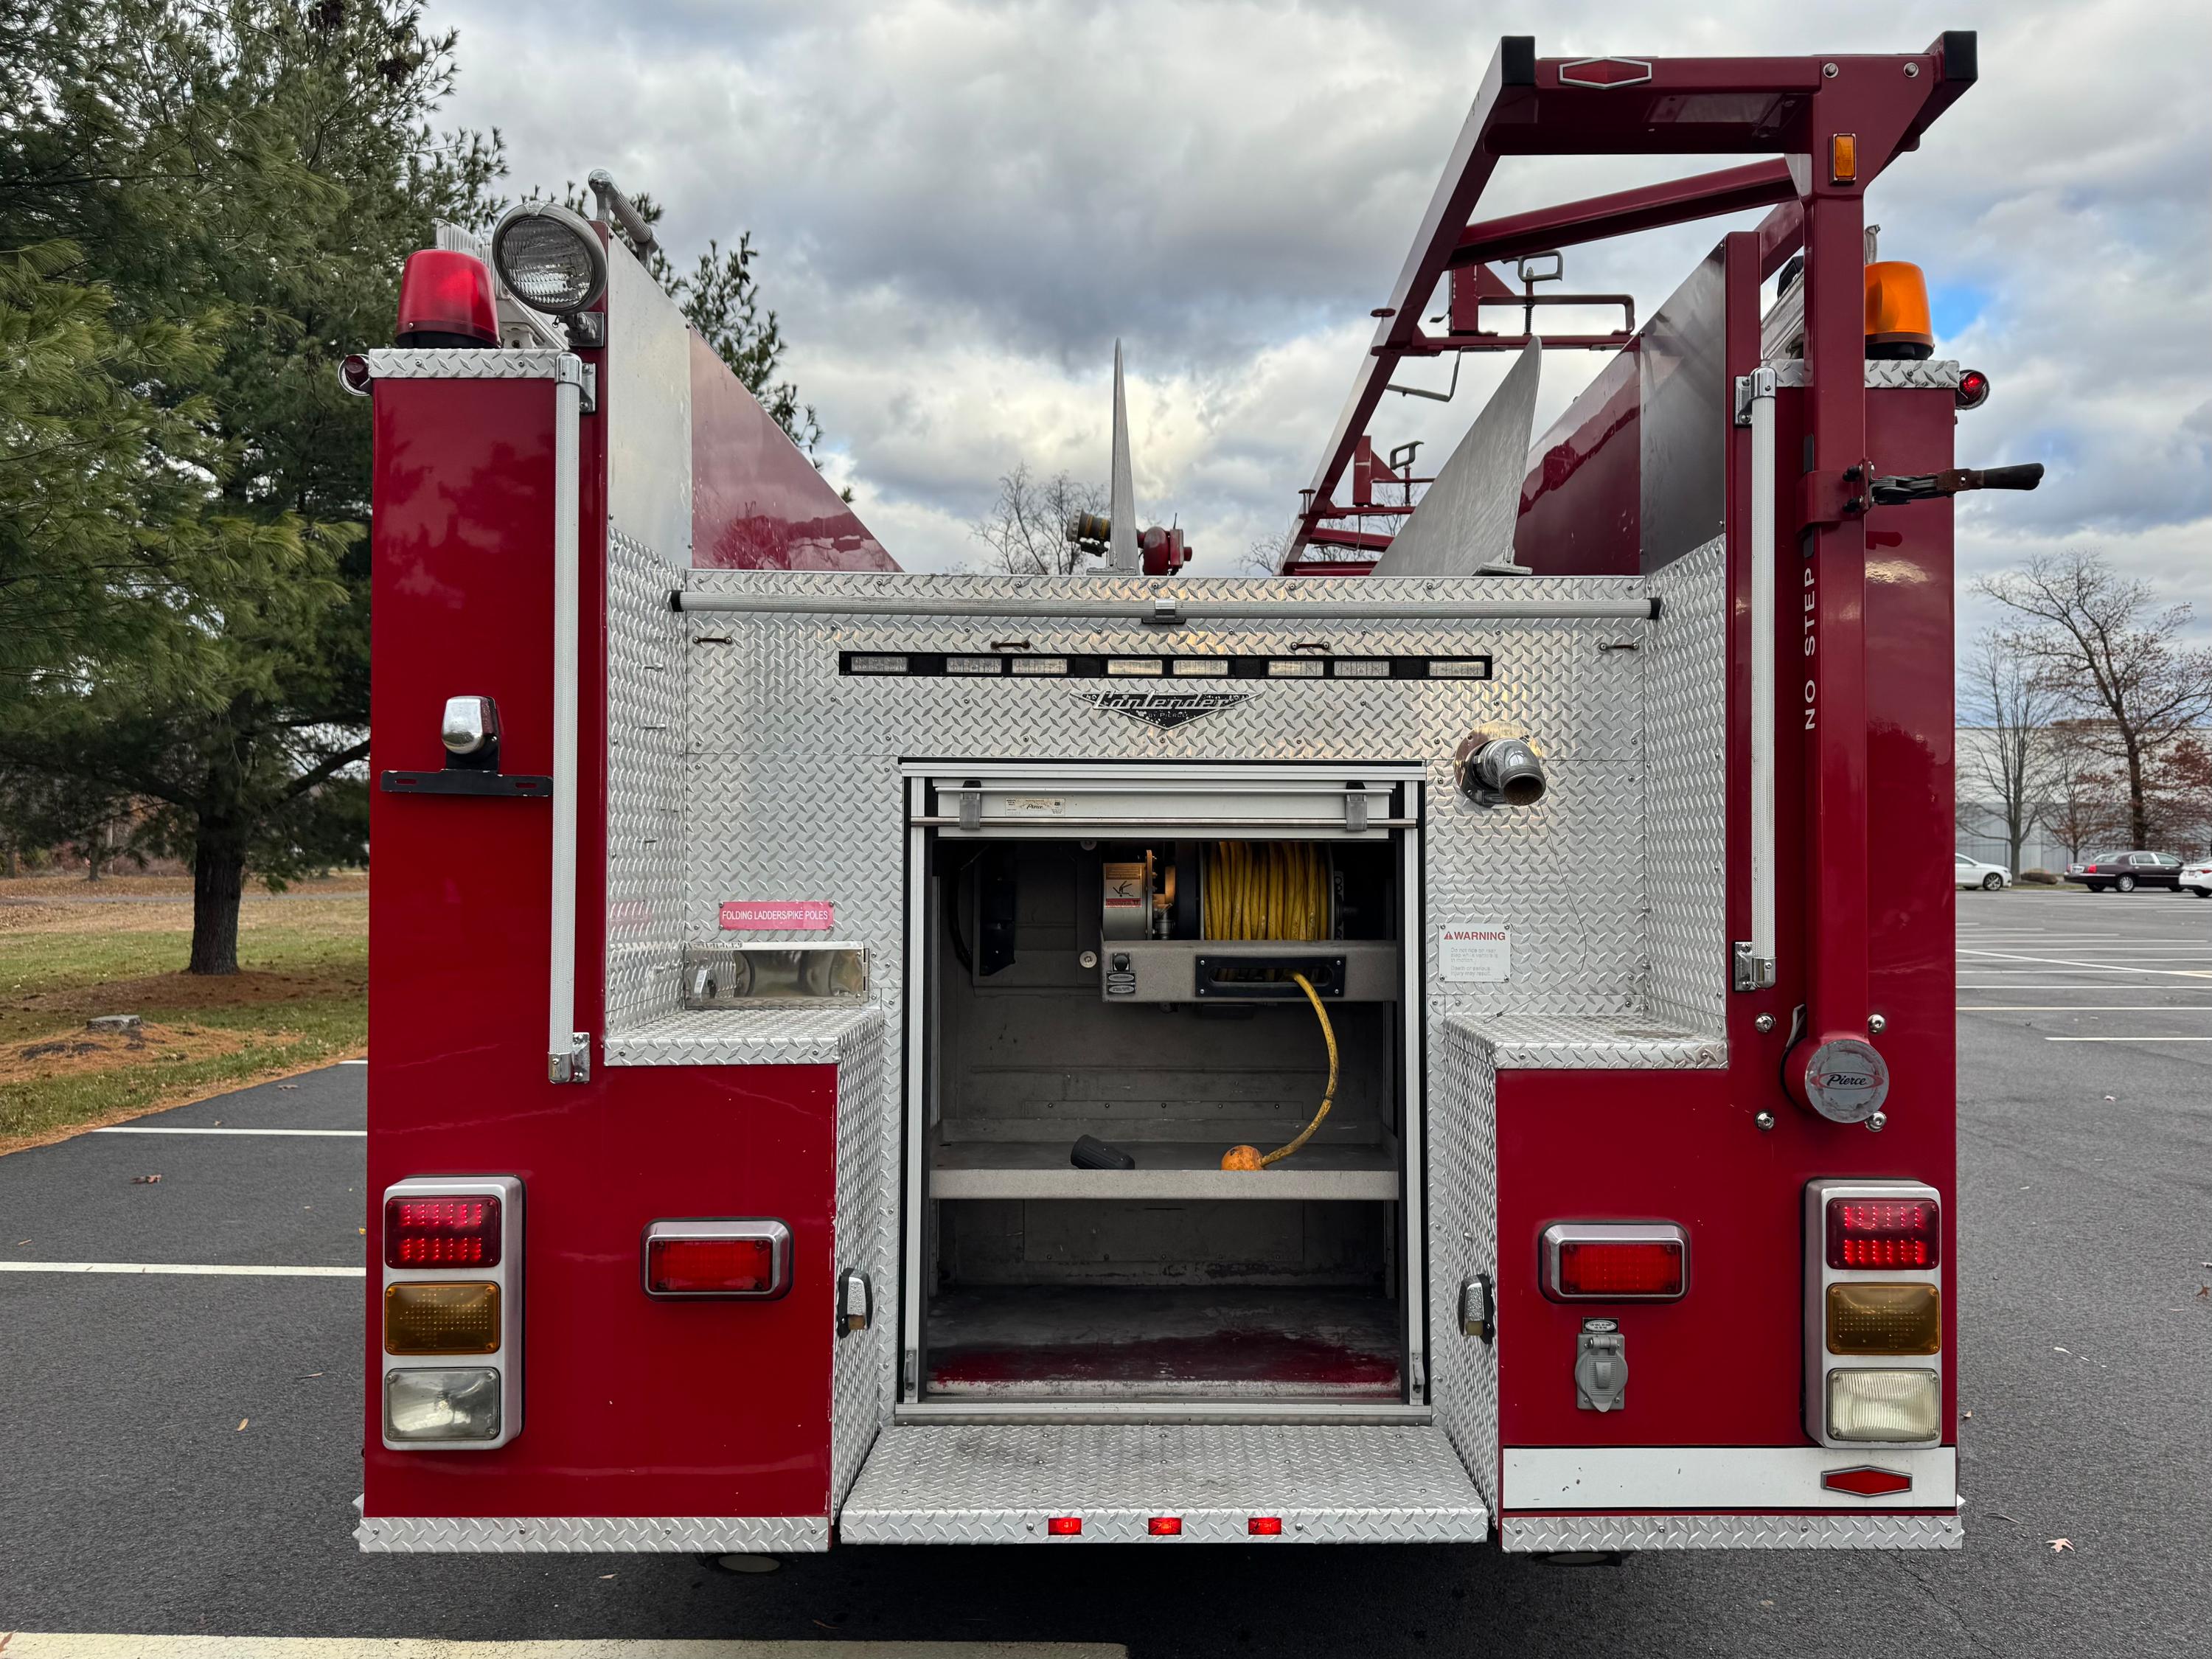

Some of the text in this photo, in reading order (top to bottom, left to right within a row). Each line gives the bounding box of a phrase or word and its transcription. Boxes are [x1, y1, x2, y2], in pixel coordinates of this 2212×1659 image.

[1804, 566, 1816, 730] NO STEP
[1093, 690, 1234, 710] Contender
[722, 911, 828, 920] FOLDING LADDERS/PIKE POLES
[1454, 931, 1506, 941] WARNING
[1826, 1074, 1867, 1087] Pierce
